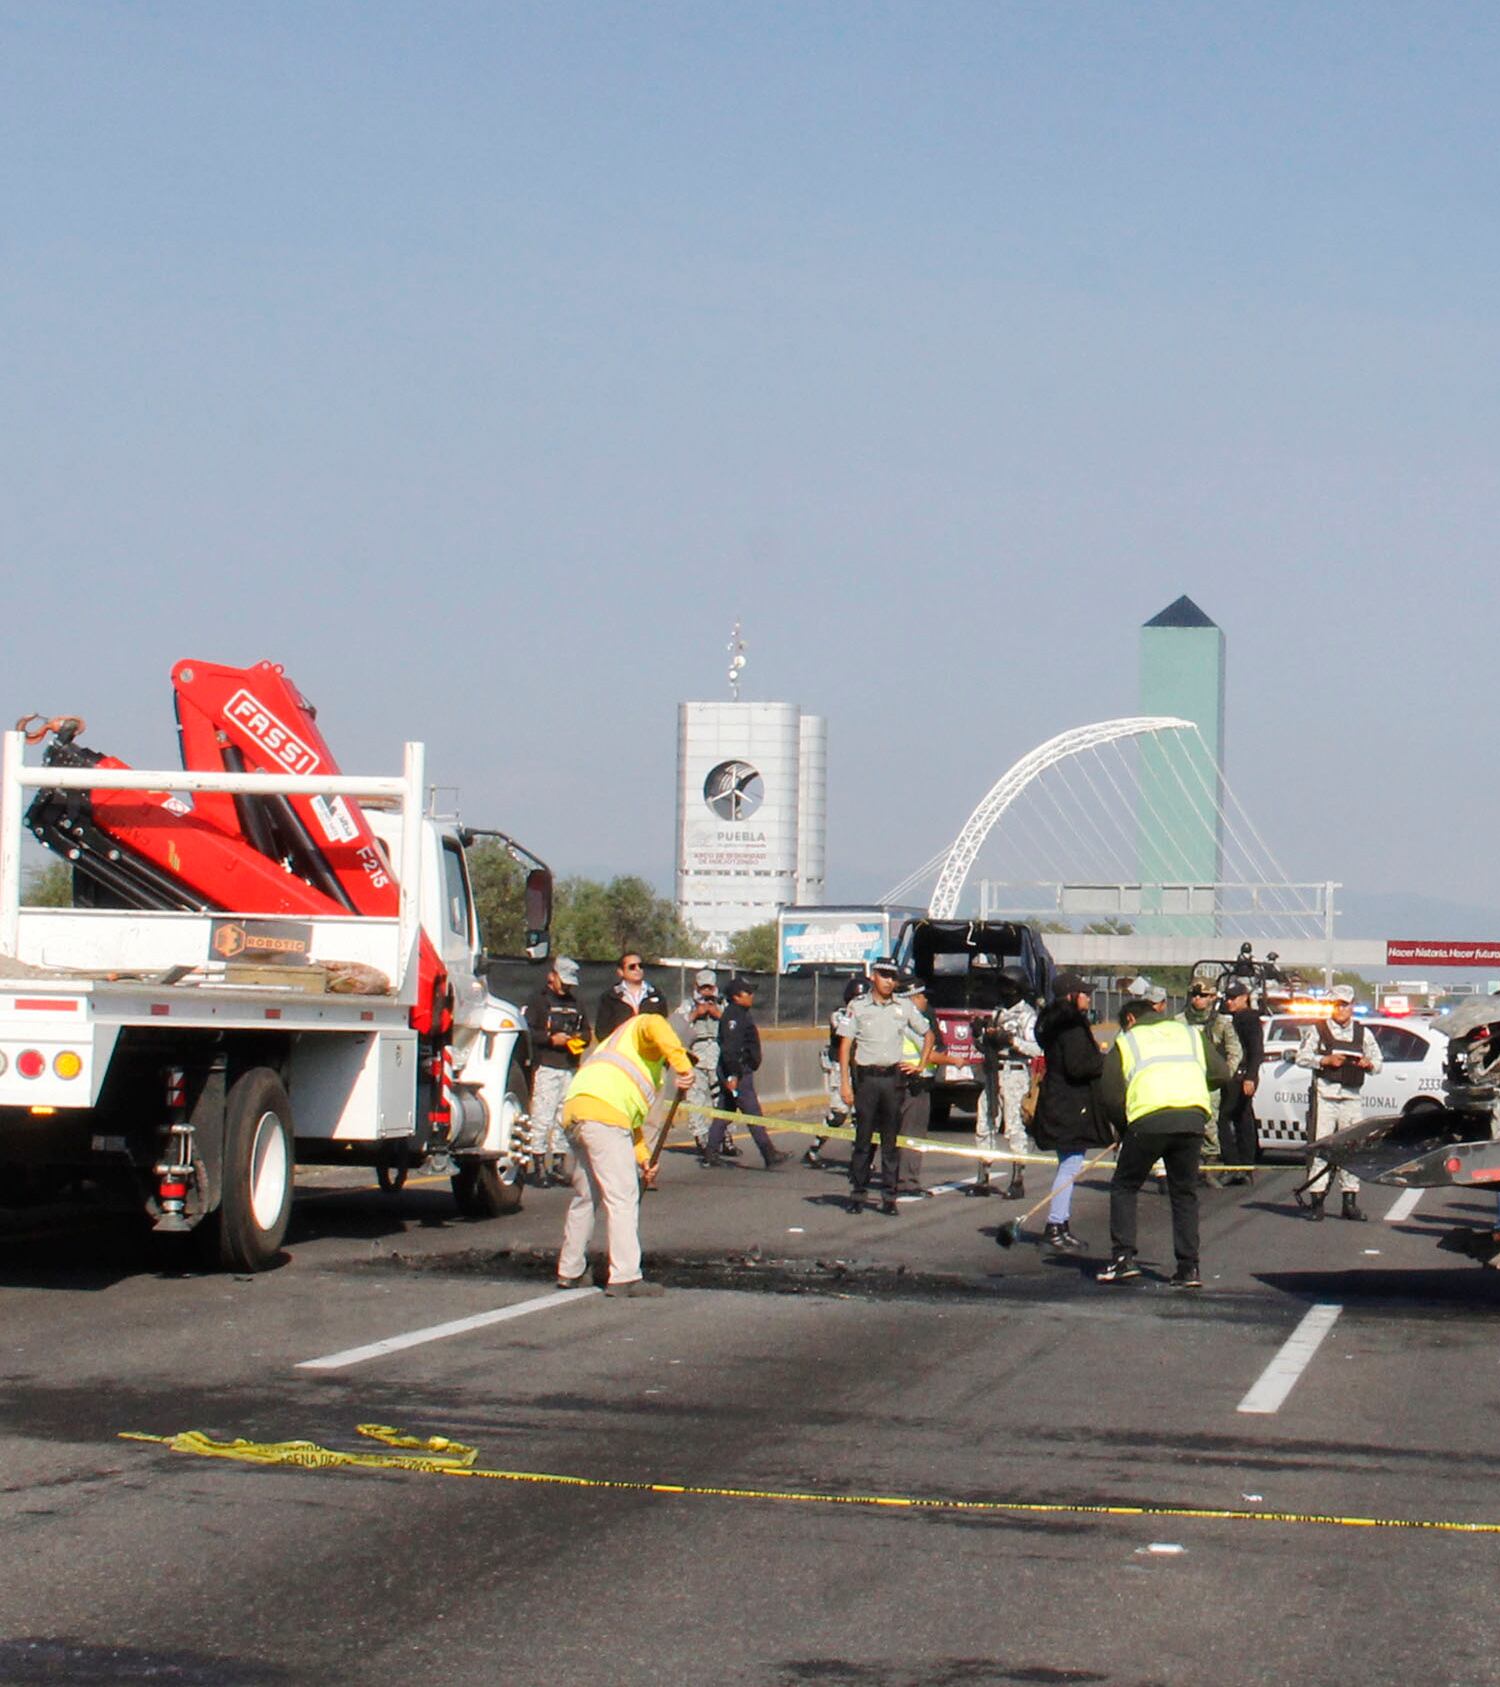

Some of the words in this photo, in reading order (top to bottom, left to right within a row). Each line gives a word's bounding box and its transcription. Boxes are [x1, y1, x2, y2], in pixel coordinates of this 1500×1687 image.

[233, 700, 310, 771] FASSI
[717, 831, 766, 841] PUEBLA
[356, 846, 390, 889] F215
[246, 936, 304, 951] ROBOTIC
[1388, 947, 1414, 957] Hacer
[1415, 948, 1448, 958] historia.
[1449, 948, 1474, 958] Hacer
[1274, 1091, 1310, 1104] GUARD
